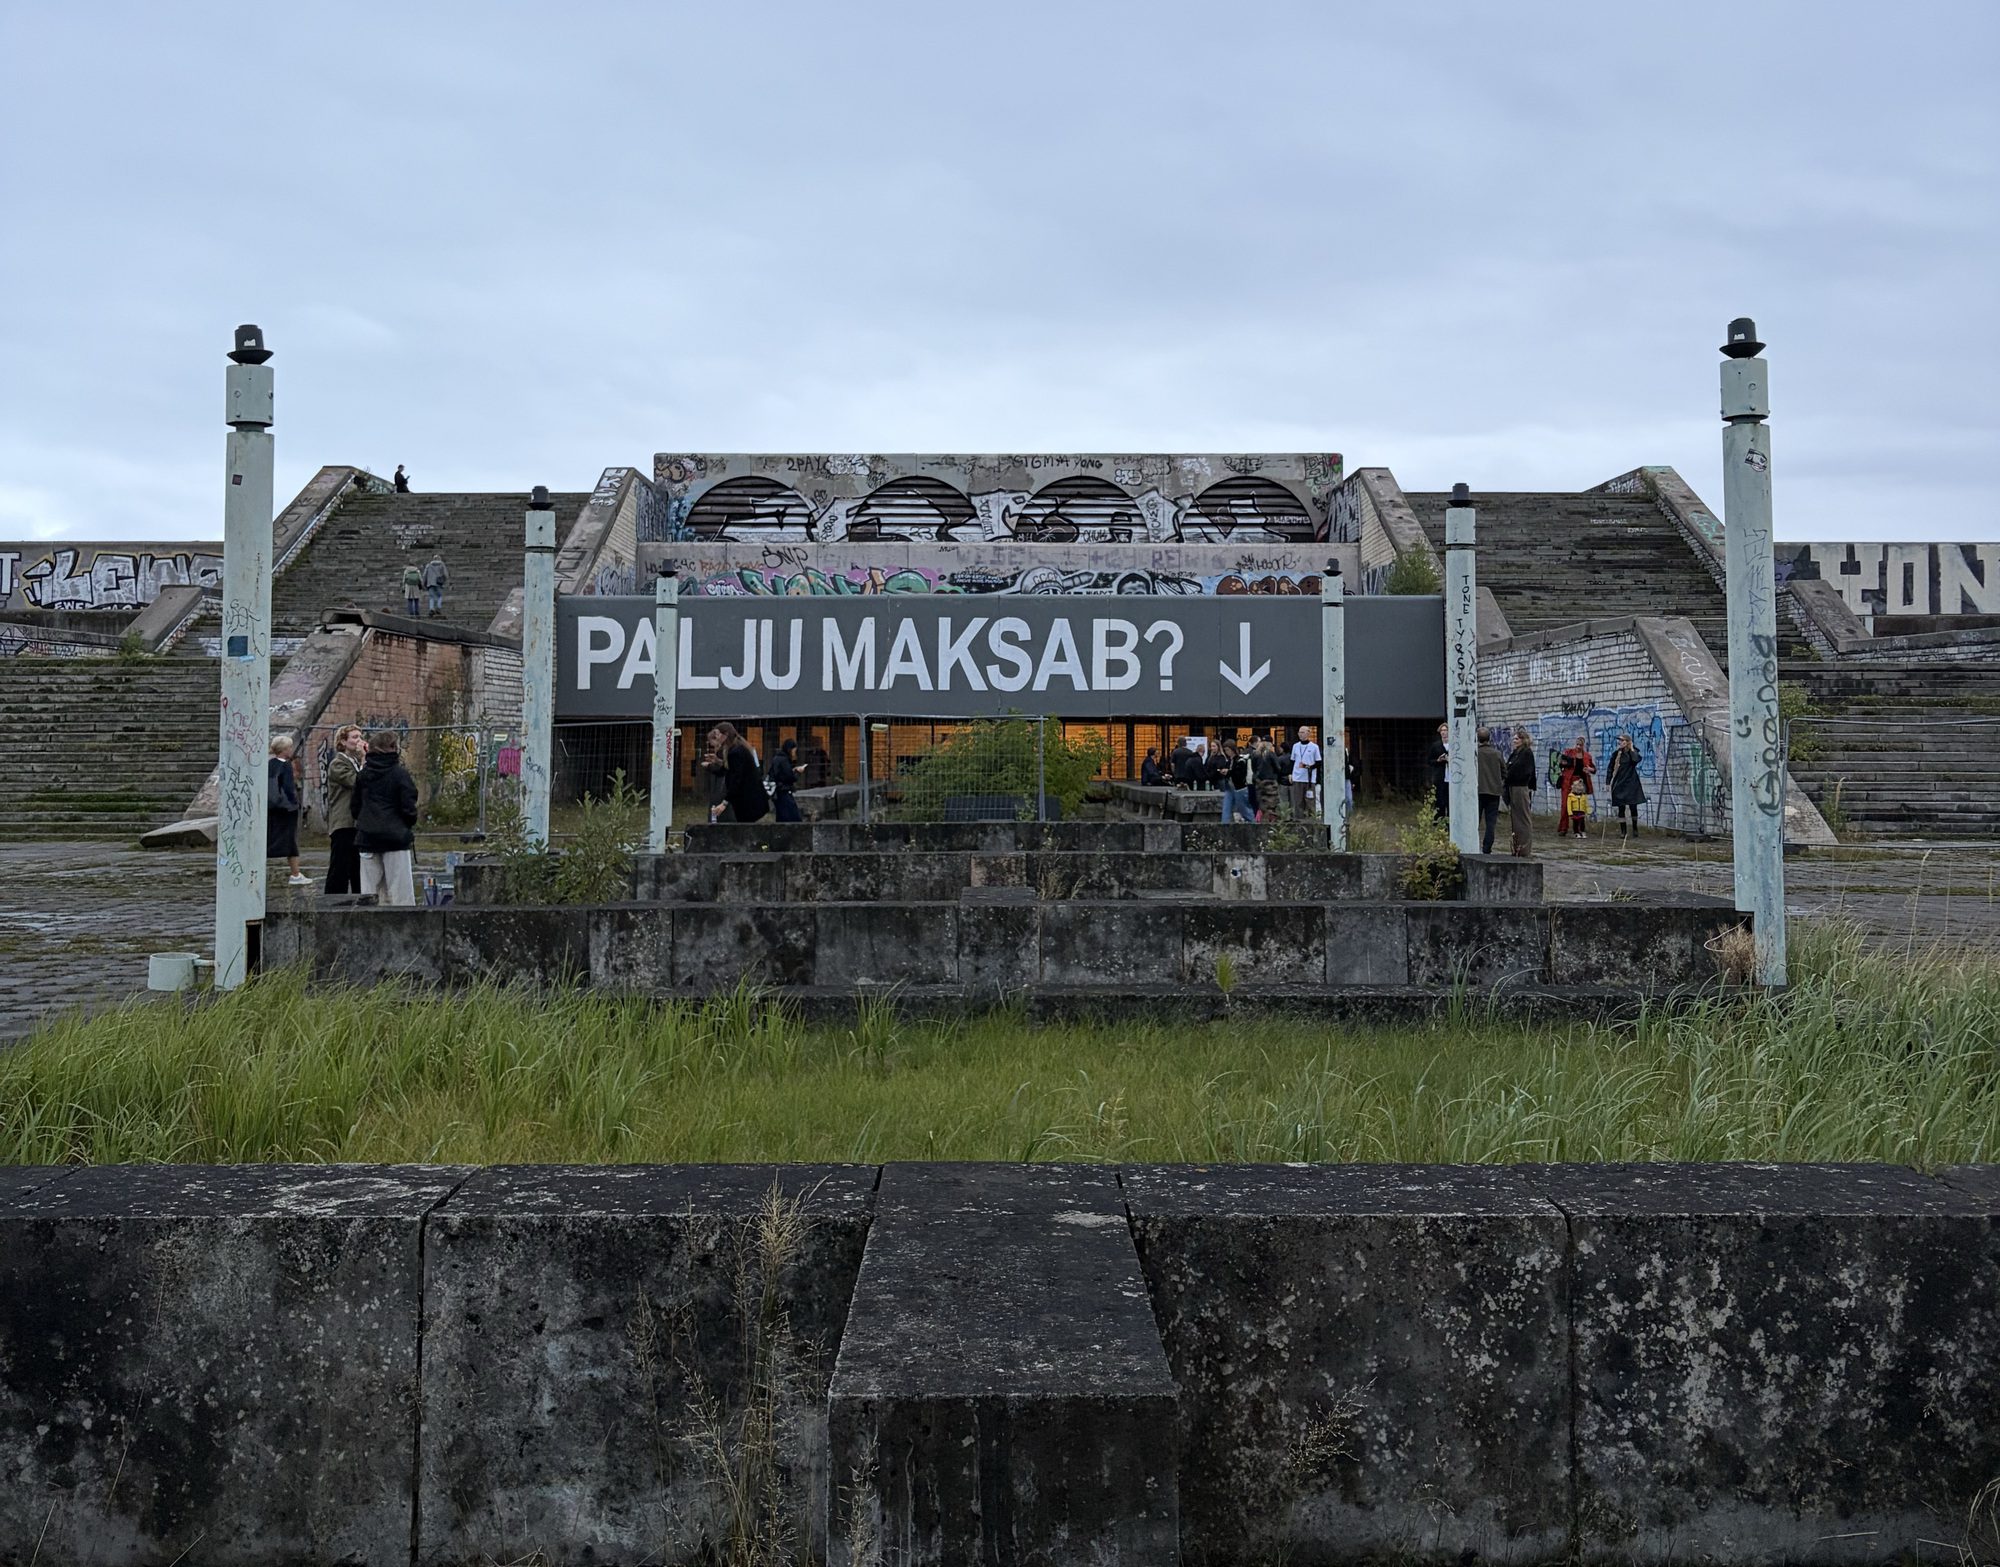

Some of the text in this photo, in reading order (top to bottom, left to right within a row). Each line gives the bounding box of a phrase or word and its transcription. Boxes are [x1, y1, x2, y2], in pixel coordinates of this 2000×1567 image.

[1461, 574, 1471, 615] TONE
[577, 616, 1184, 692] PALJU MAKSAB?
